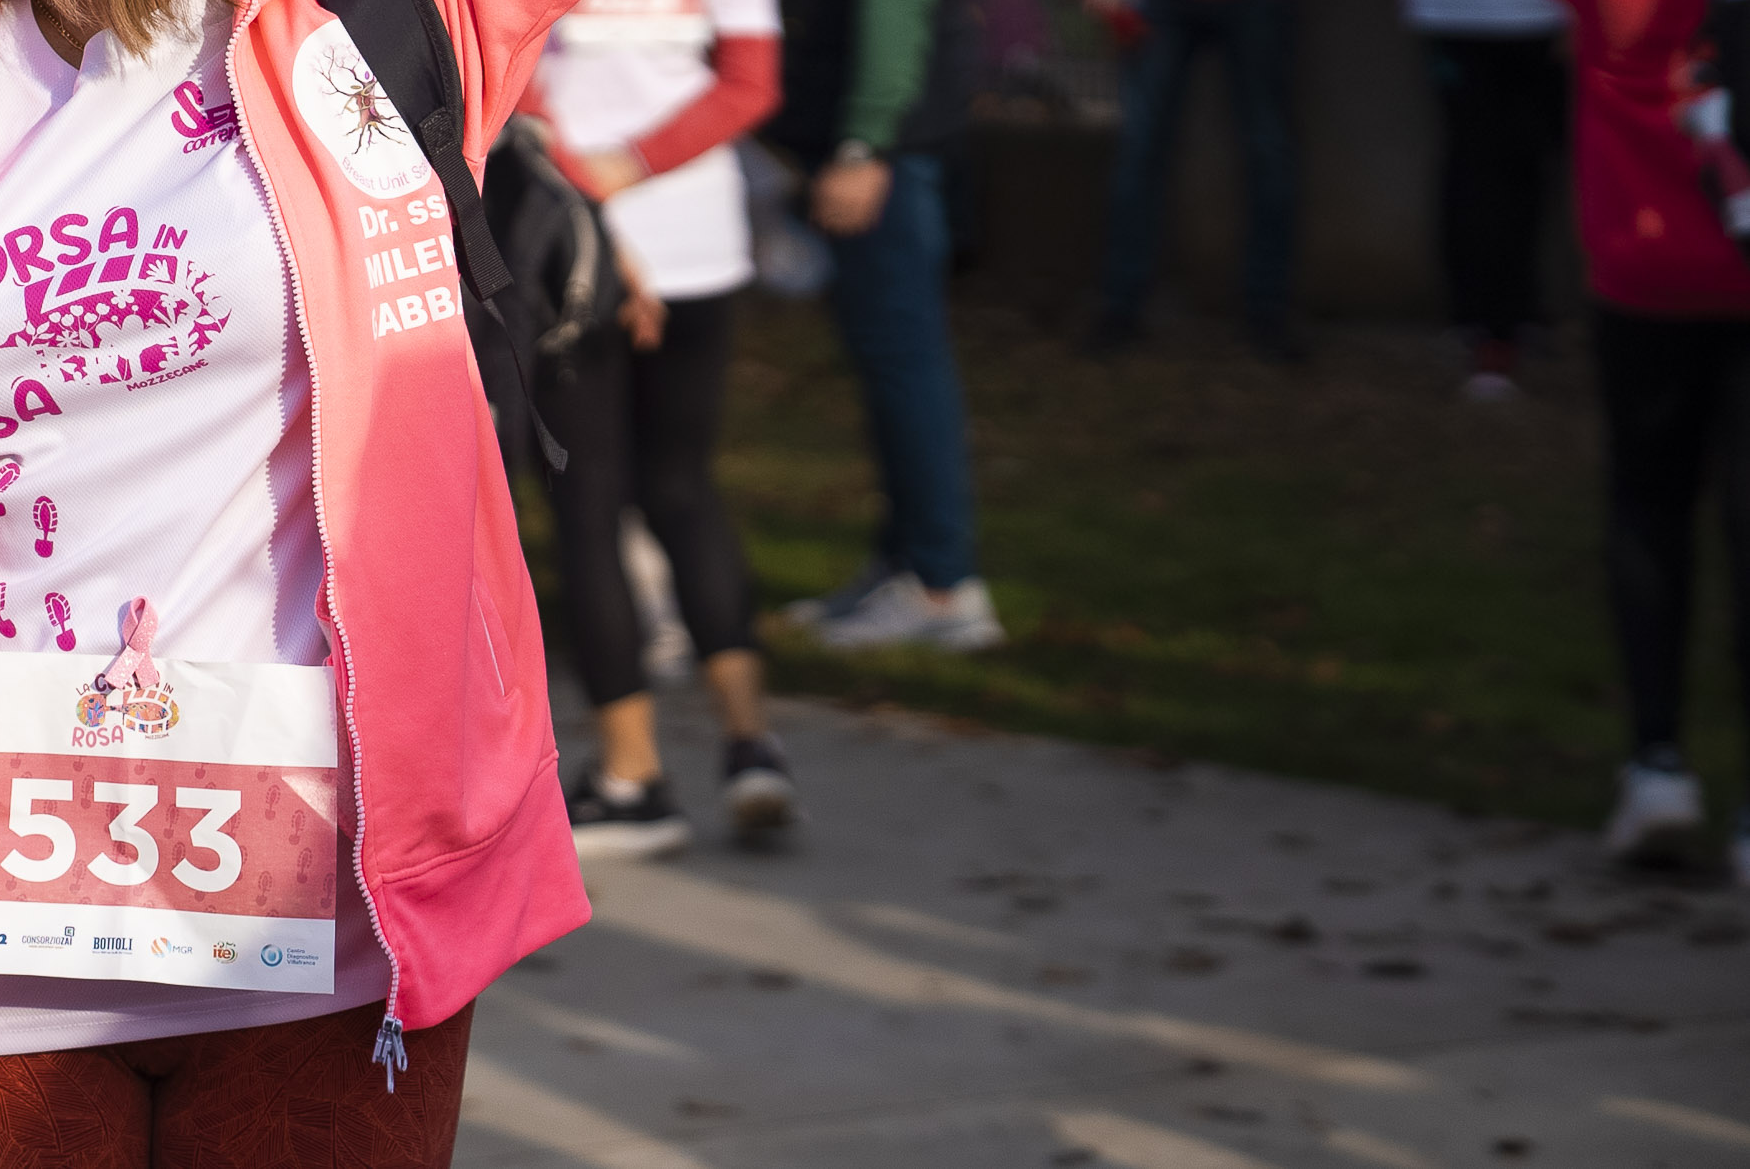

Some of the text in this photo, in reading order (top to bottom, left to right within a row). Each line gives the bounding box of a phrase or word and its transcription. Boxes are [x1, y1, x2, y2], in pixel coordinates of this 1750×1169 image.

[378, 171, 410, 190] Unit
[358, 205, 399, 239] Dr.
[153, 223, 188, 249] IN
[75, 683, 90, 696] LA
[163, 682, 174, 694] IN
[71, 725, 124, 748] ROSA
[0, 777, 243, 893] 533
[93, 936, 133, 951] BOTTOLI
[172, 945, 193, 955] MGR
